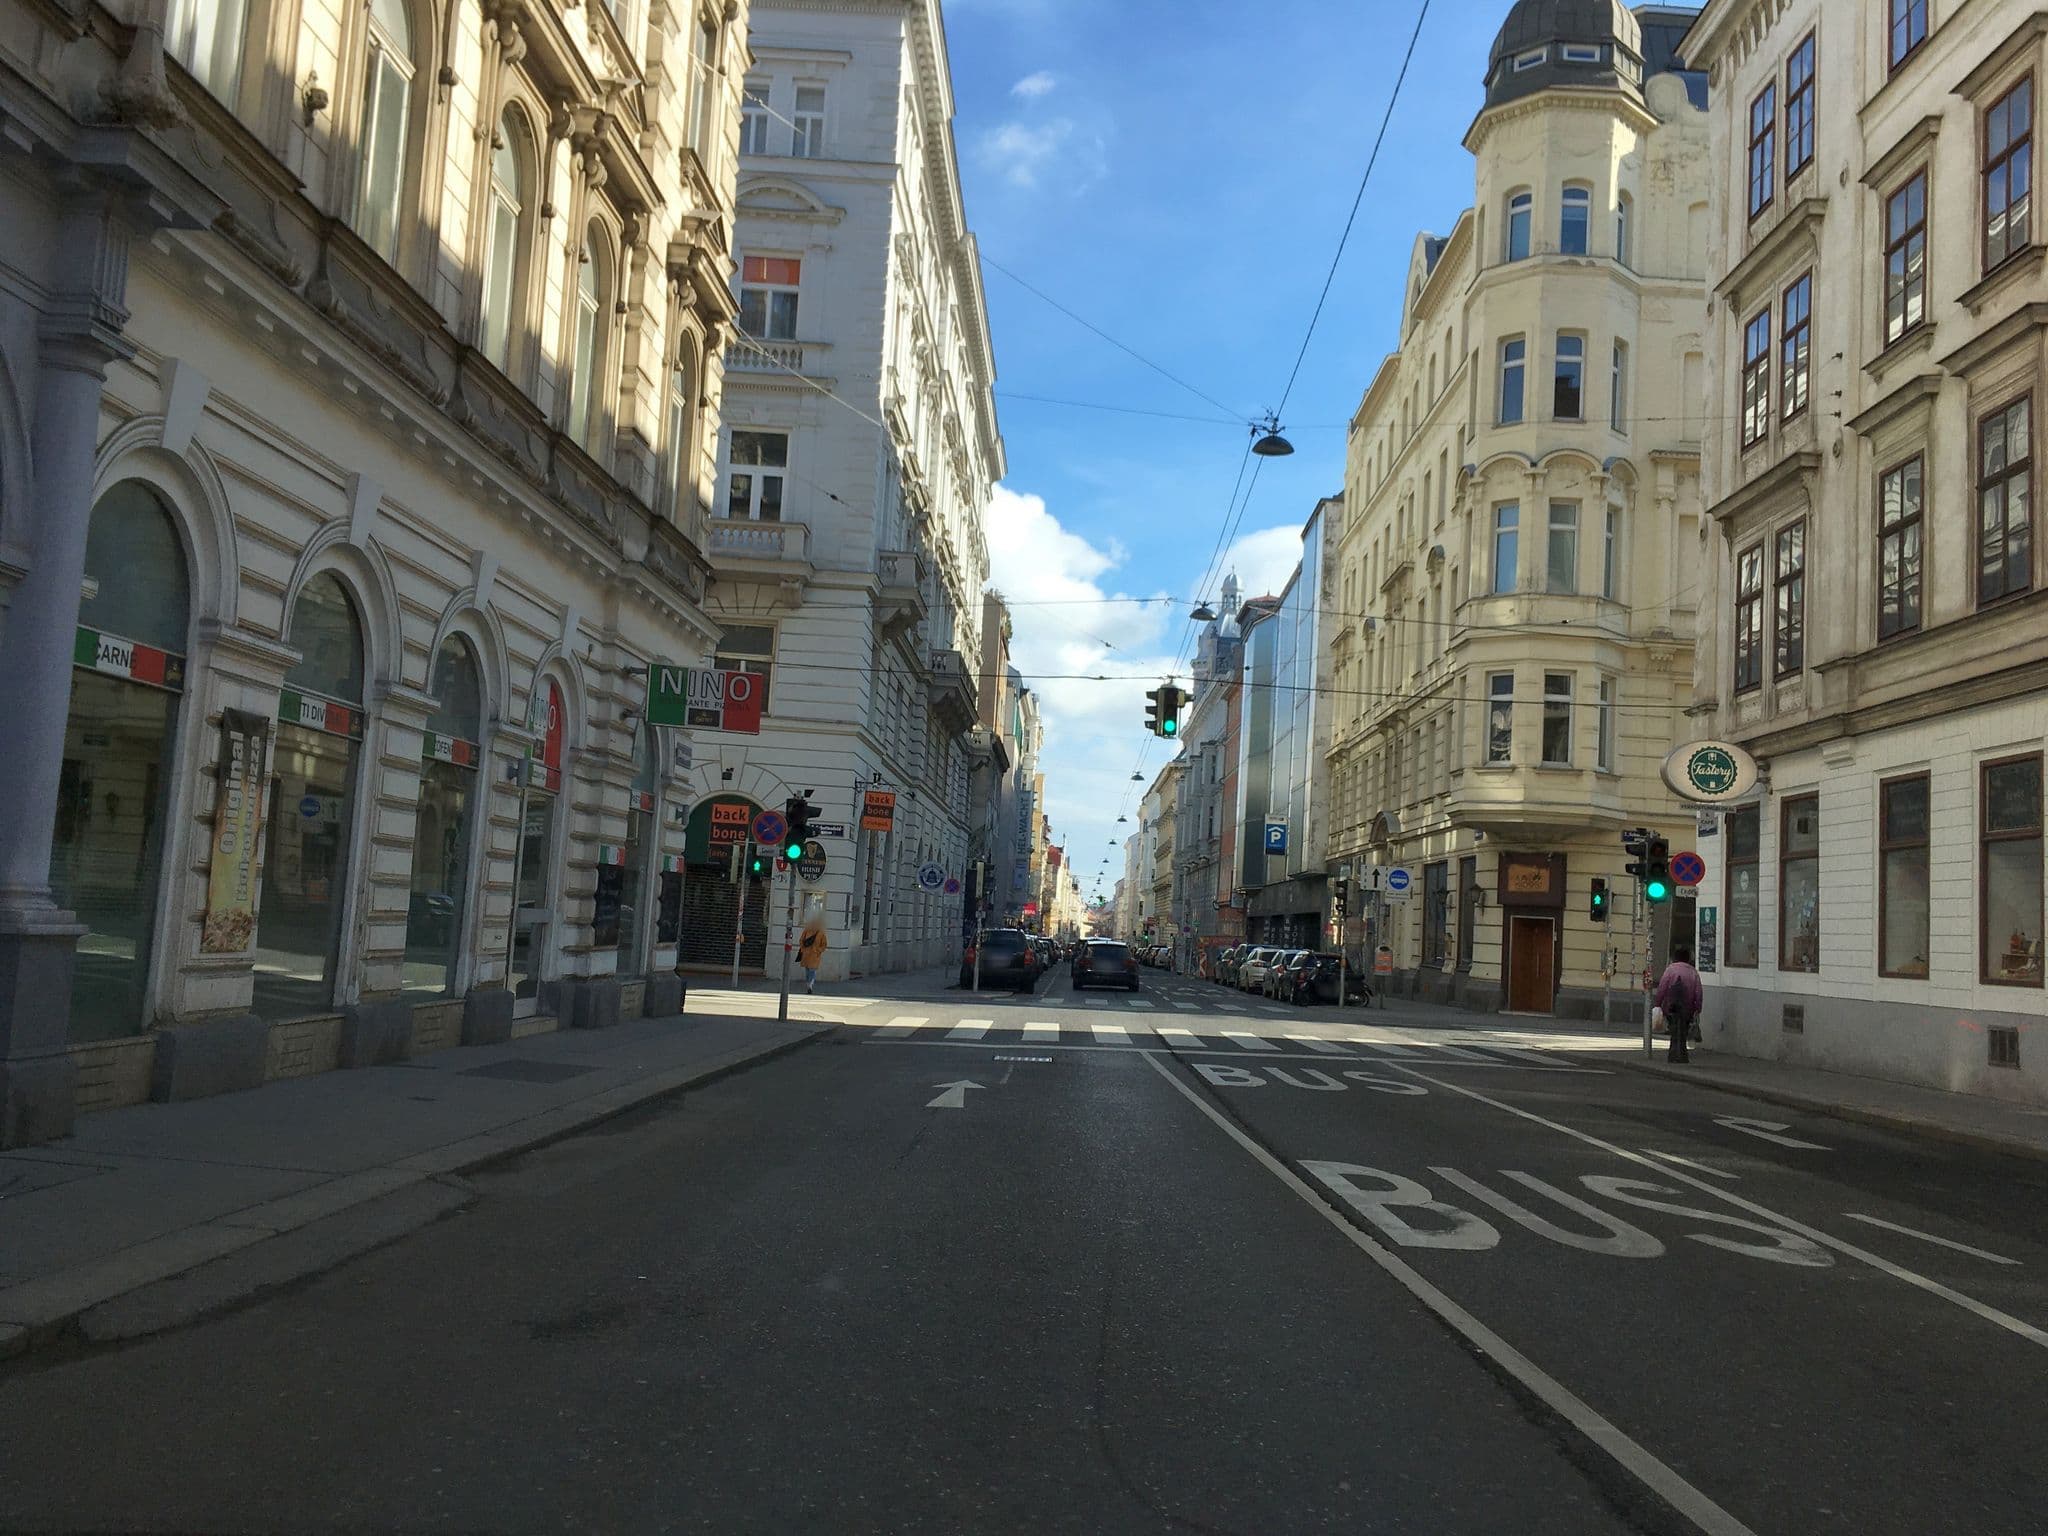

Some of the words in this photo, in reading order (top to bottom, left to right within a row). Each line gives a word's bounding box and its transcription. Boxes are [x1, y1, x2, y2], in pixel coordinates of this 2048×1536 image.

[660, 667, 751, 702] NINO
[219, 730, 244, 855] Original
[868, 794, 890, 804] back
[714, 807, 746, 821] back
[867, 806, 890, 816] bone
[713, 825, 746, 840] bone
[1271, 831, 1281, 843] P
[1191, 1063, 1429, 1096] BUS
[1297, 1159, 1835, 1267] BUS
